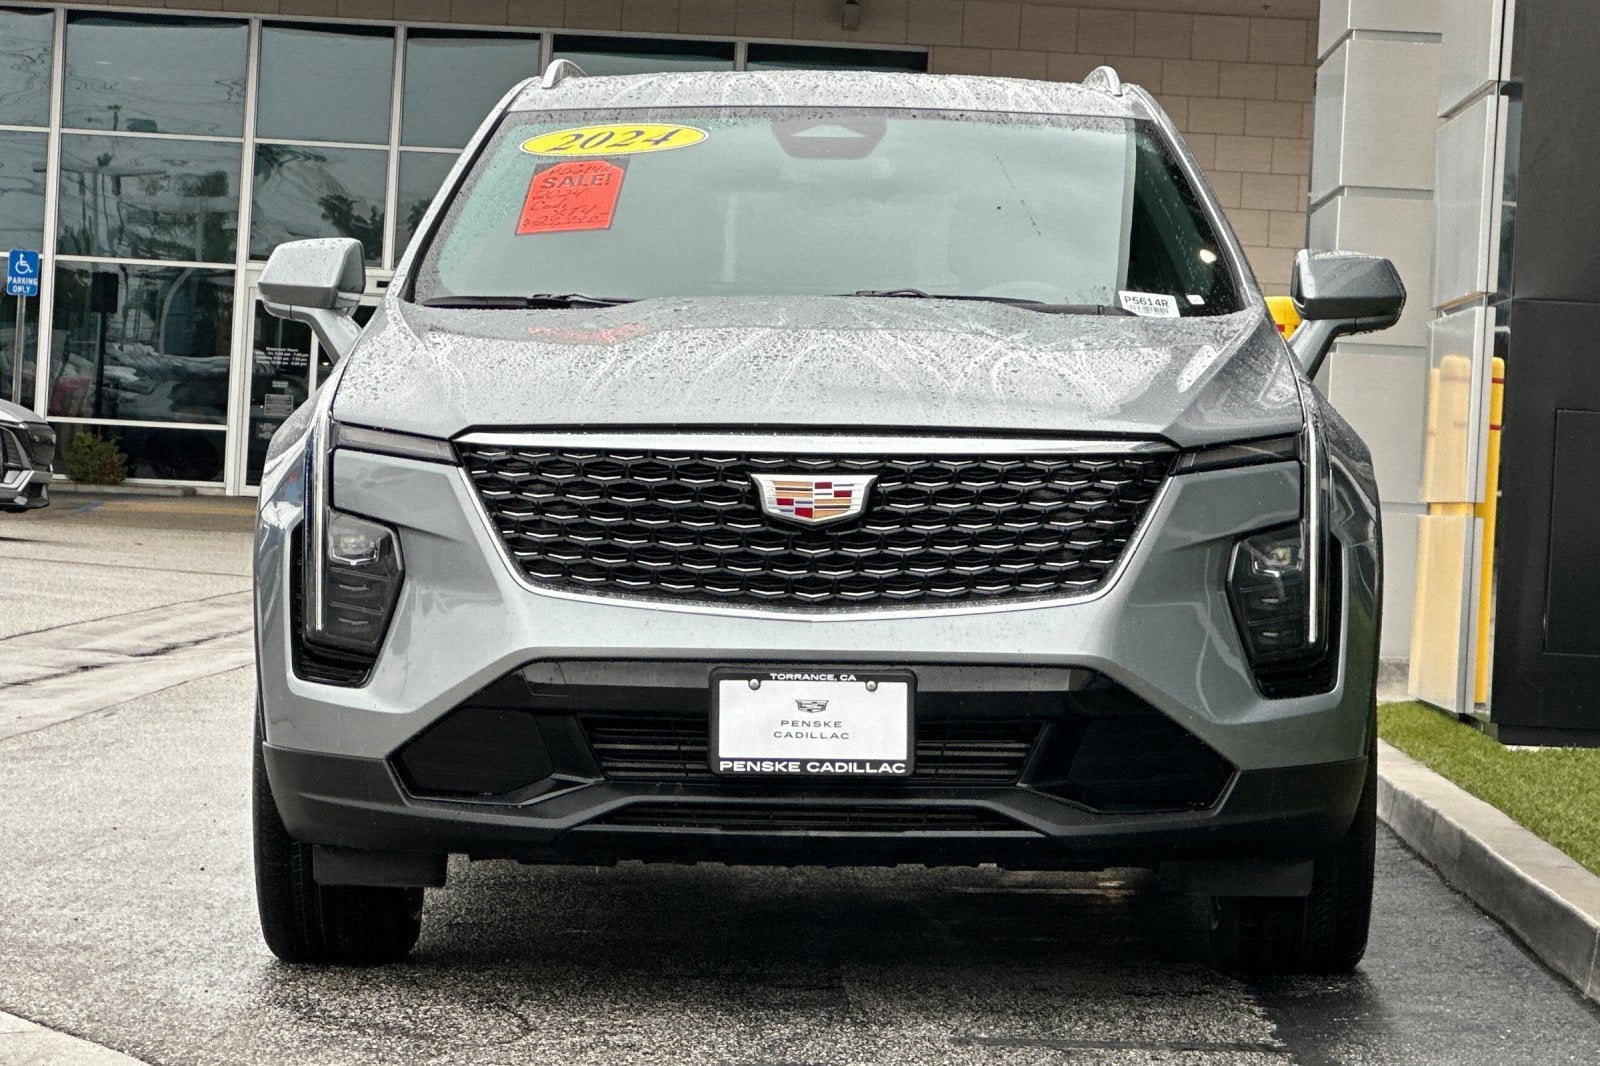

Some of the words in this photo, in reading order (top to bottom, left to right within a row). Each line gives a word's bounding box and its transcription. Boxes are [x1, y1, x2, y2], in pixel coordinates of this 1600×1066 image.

[544, 128, 682, 152] 2024
[541, 173, 612, 189] SALE!
[8, 276, 38, 285] PARKING
[12, 285, 31, 293] ONLY
[1124, 295, 1169, 308] P5614R
[770, 673, 838, 682] TORRANCE,
[839, 674, 857, 682] CA
[780, 719, 842, 728] PENSKE
[773, 731, 850, 740] CADILLAC
[719, 761, 801, 772] PENSKE
[806, 762, 906, 774] CADILLAC
